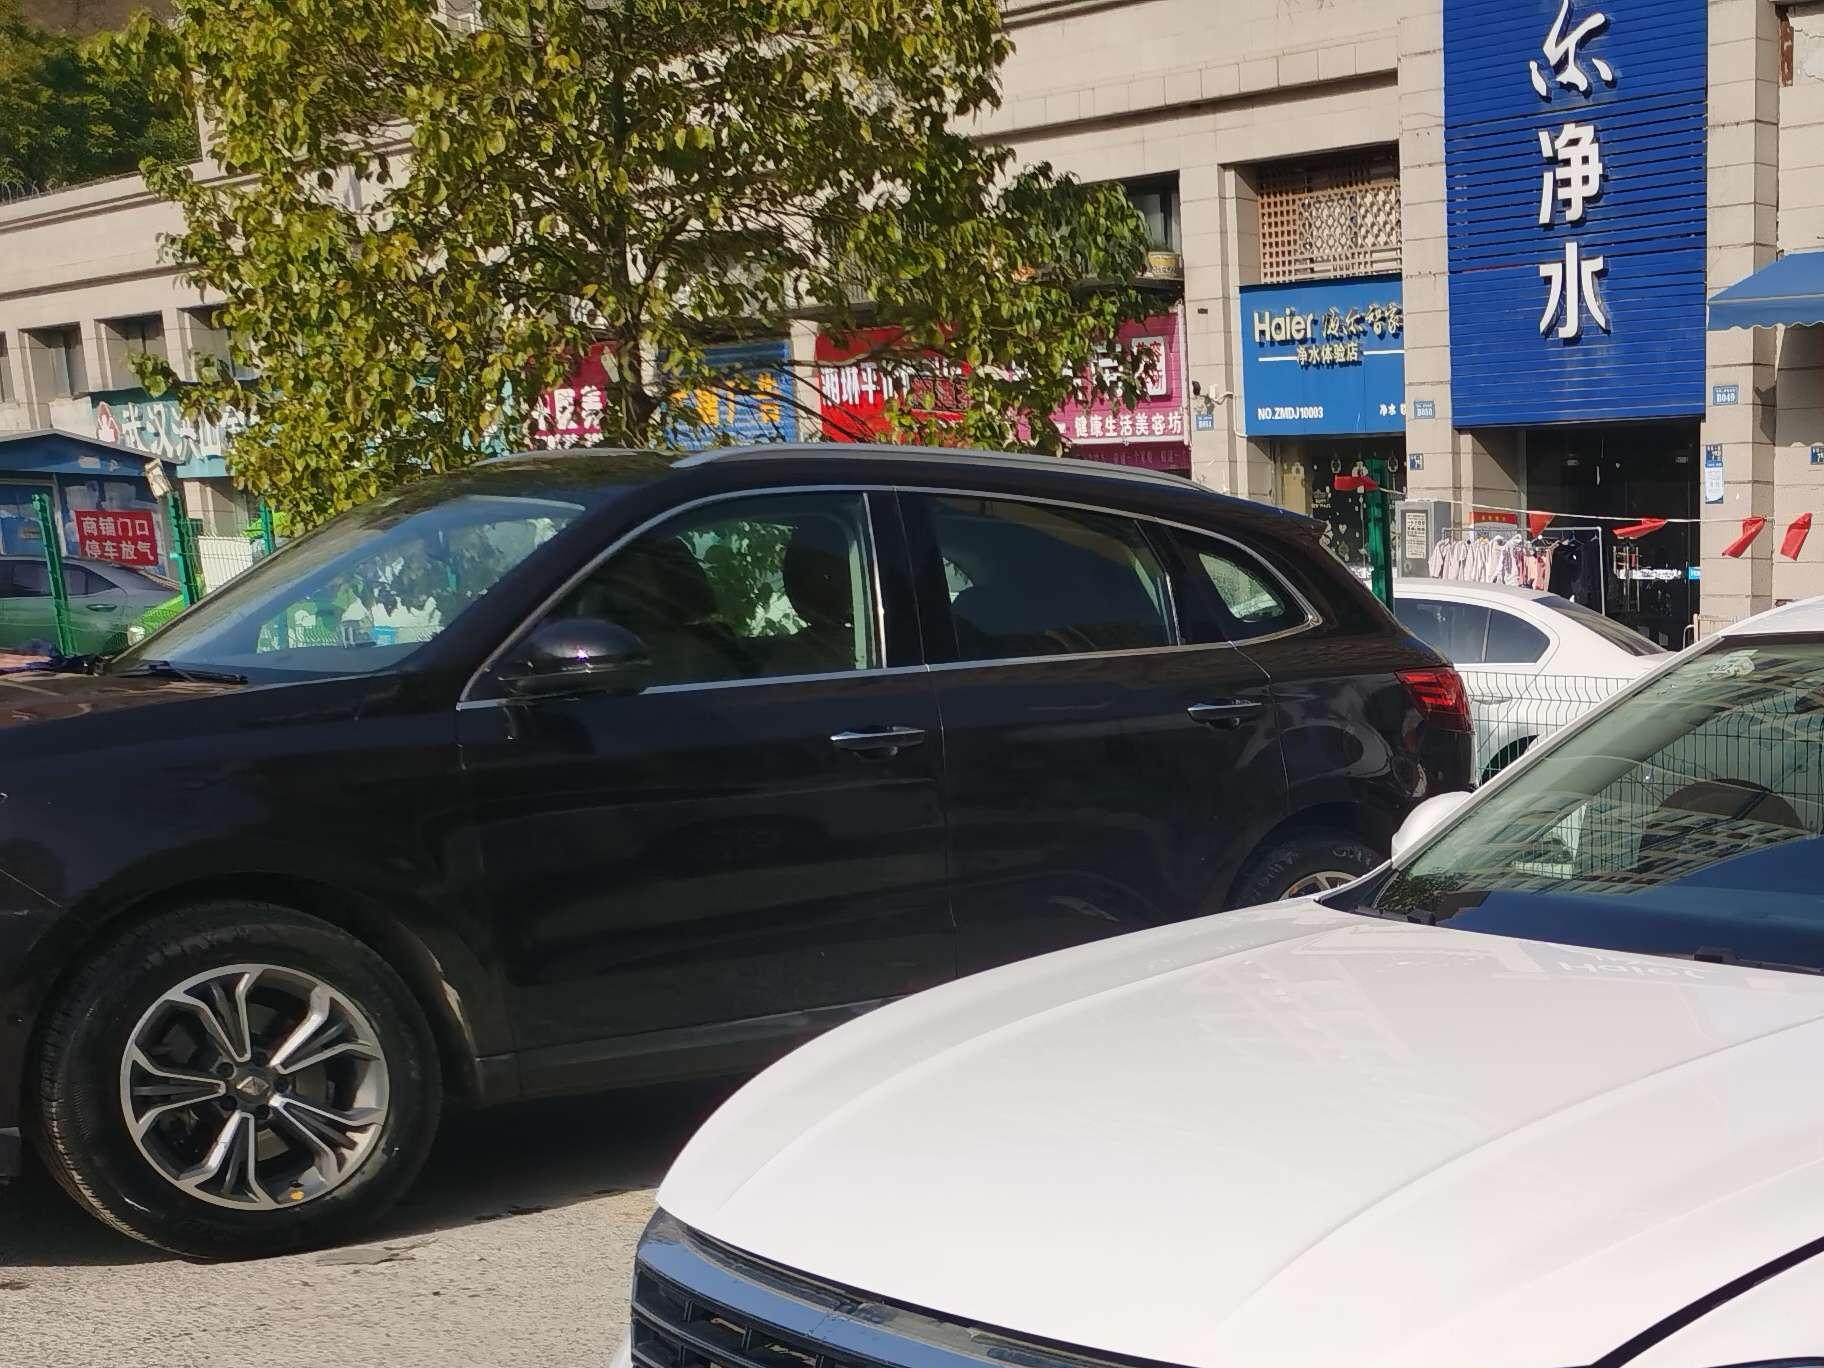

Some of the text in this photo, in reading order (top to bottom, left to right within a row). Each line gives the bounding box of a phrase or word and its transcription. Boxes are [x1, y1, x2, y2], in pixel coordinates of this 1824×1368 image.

[1253, 307, 1314, 342] Haier
[1297, 343, 1360, 366] 净水体验店
[1075, 412, 1182, 438] 健康生活美容坊
[81, 516, 150, 537] 商铺门口
[85, 540, 154, 561] 停车放气
